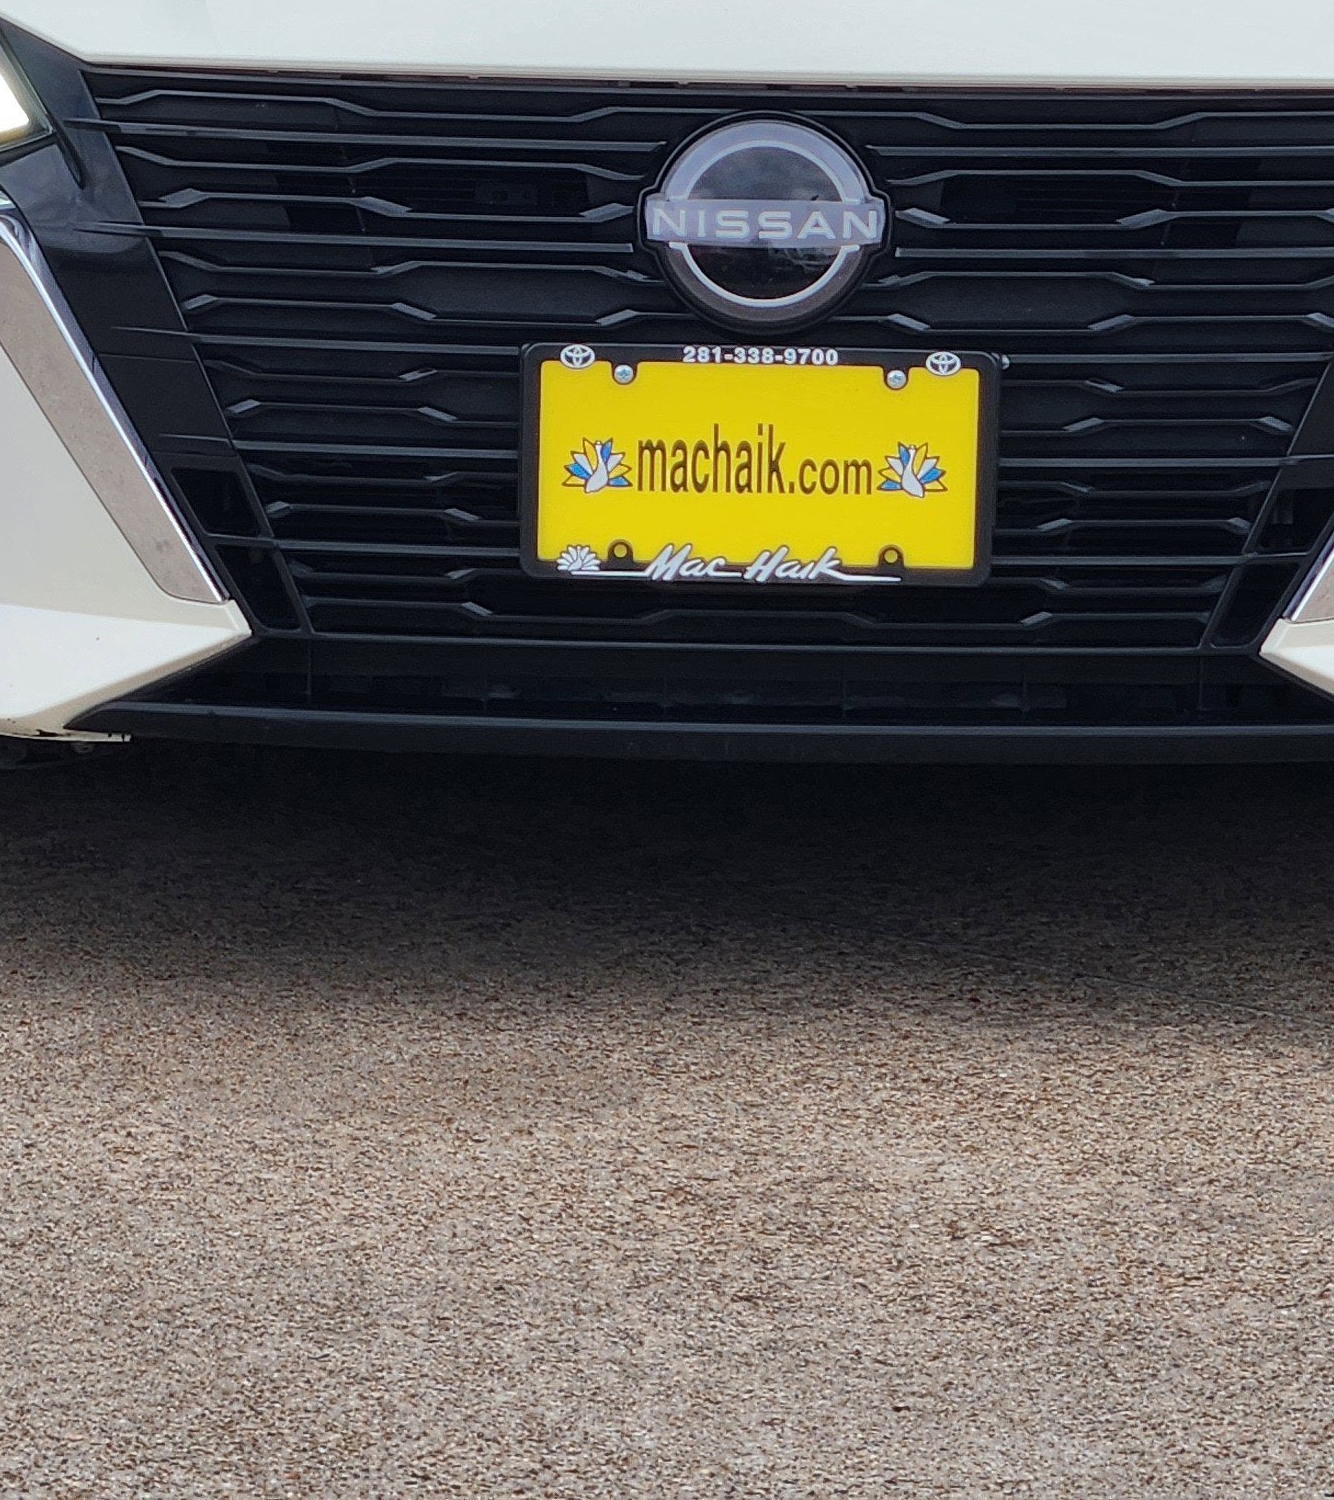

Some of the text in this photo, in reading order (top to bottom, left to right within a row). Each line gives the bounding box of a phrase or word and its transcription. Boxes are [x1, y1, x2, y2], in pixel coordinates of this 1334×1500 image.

[652, 208, 877, 240] NISSAN
[682, 345, 839, 366] 281-338-9700
[637, 422, 873, 495] machaik.com
[643, 543, 851, 583] Mac Haik
